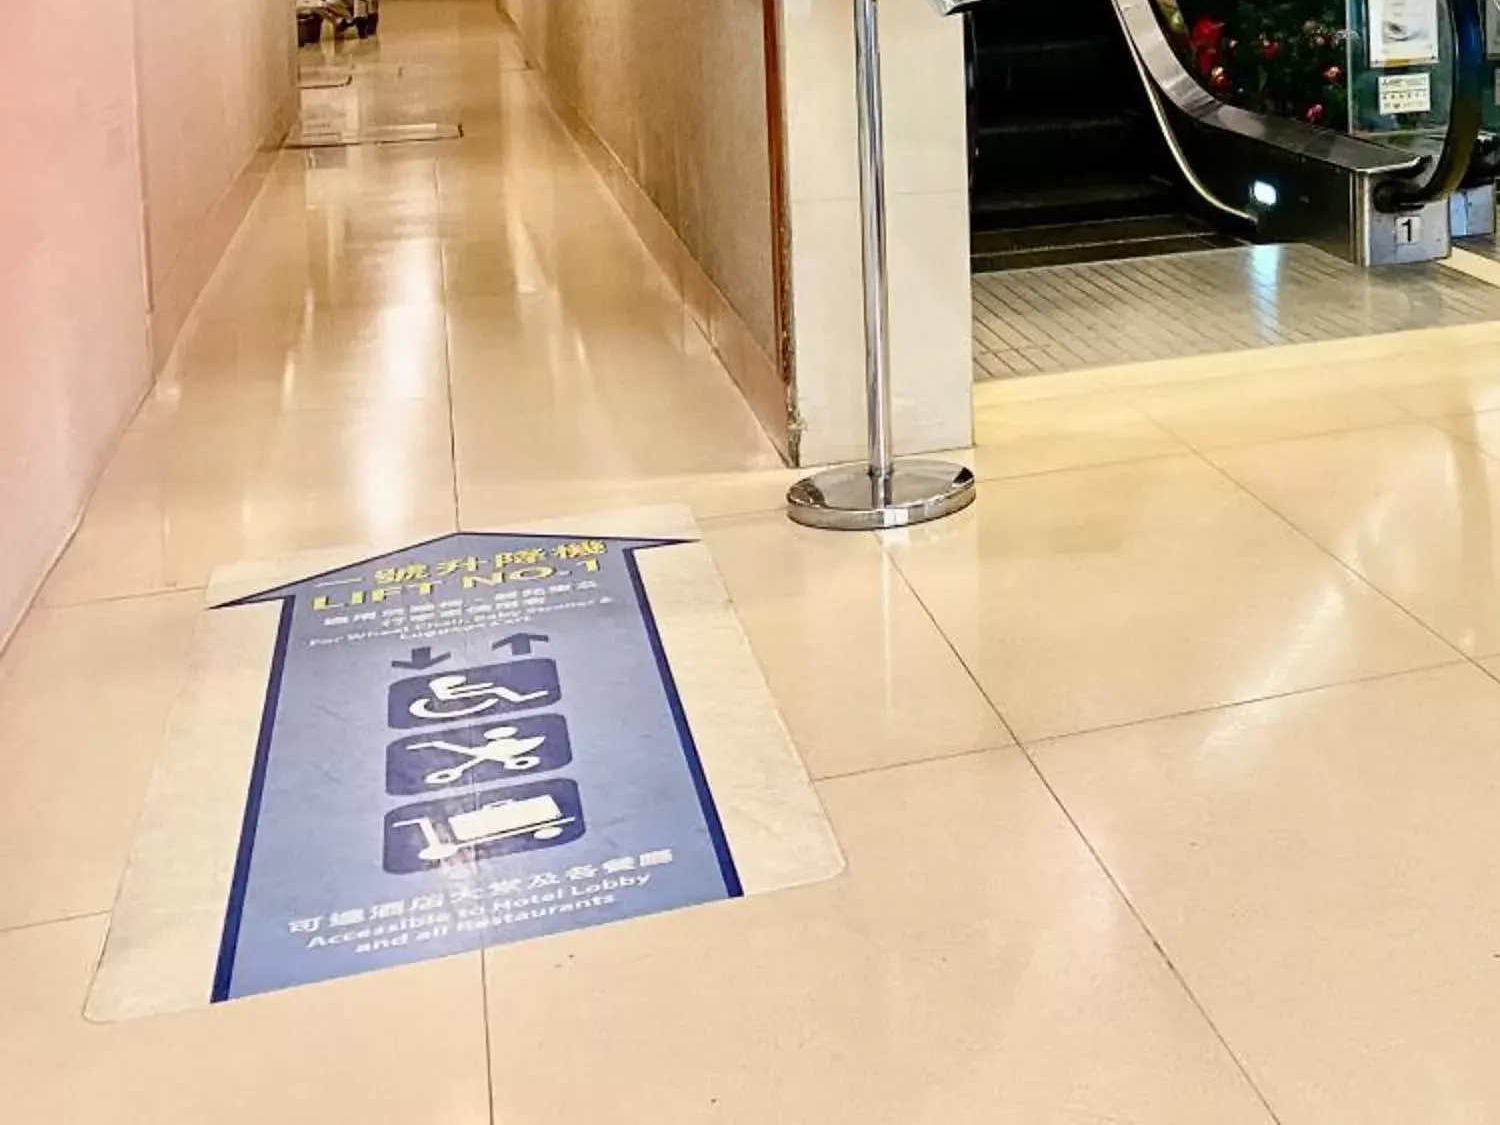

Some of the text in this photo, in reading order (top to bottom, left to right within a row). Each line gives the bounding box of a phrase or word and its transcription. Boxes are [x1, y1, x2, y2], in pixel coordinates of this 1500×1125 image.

[1401, 218, 1413, 243] 1
[312, 578, 444, 610] LIFT
[305, 912, 446, 951] Accessible
[491, 887, 563, 915] Hotel
[571, 873, 651, 898] Lobby
[354, 893, 616, 954] and all Restaurants
